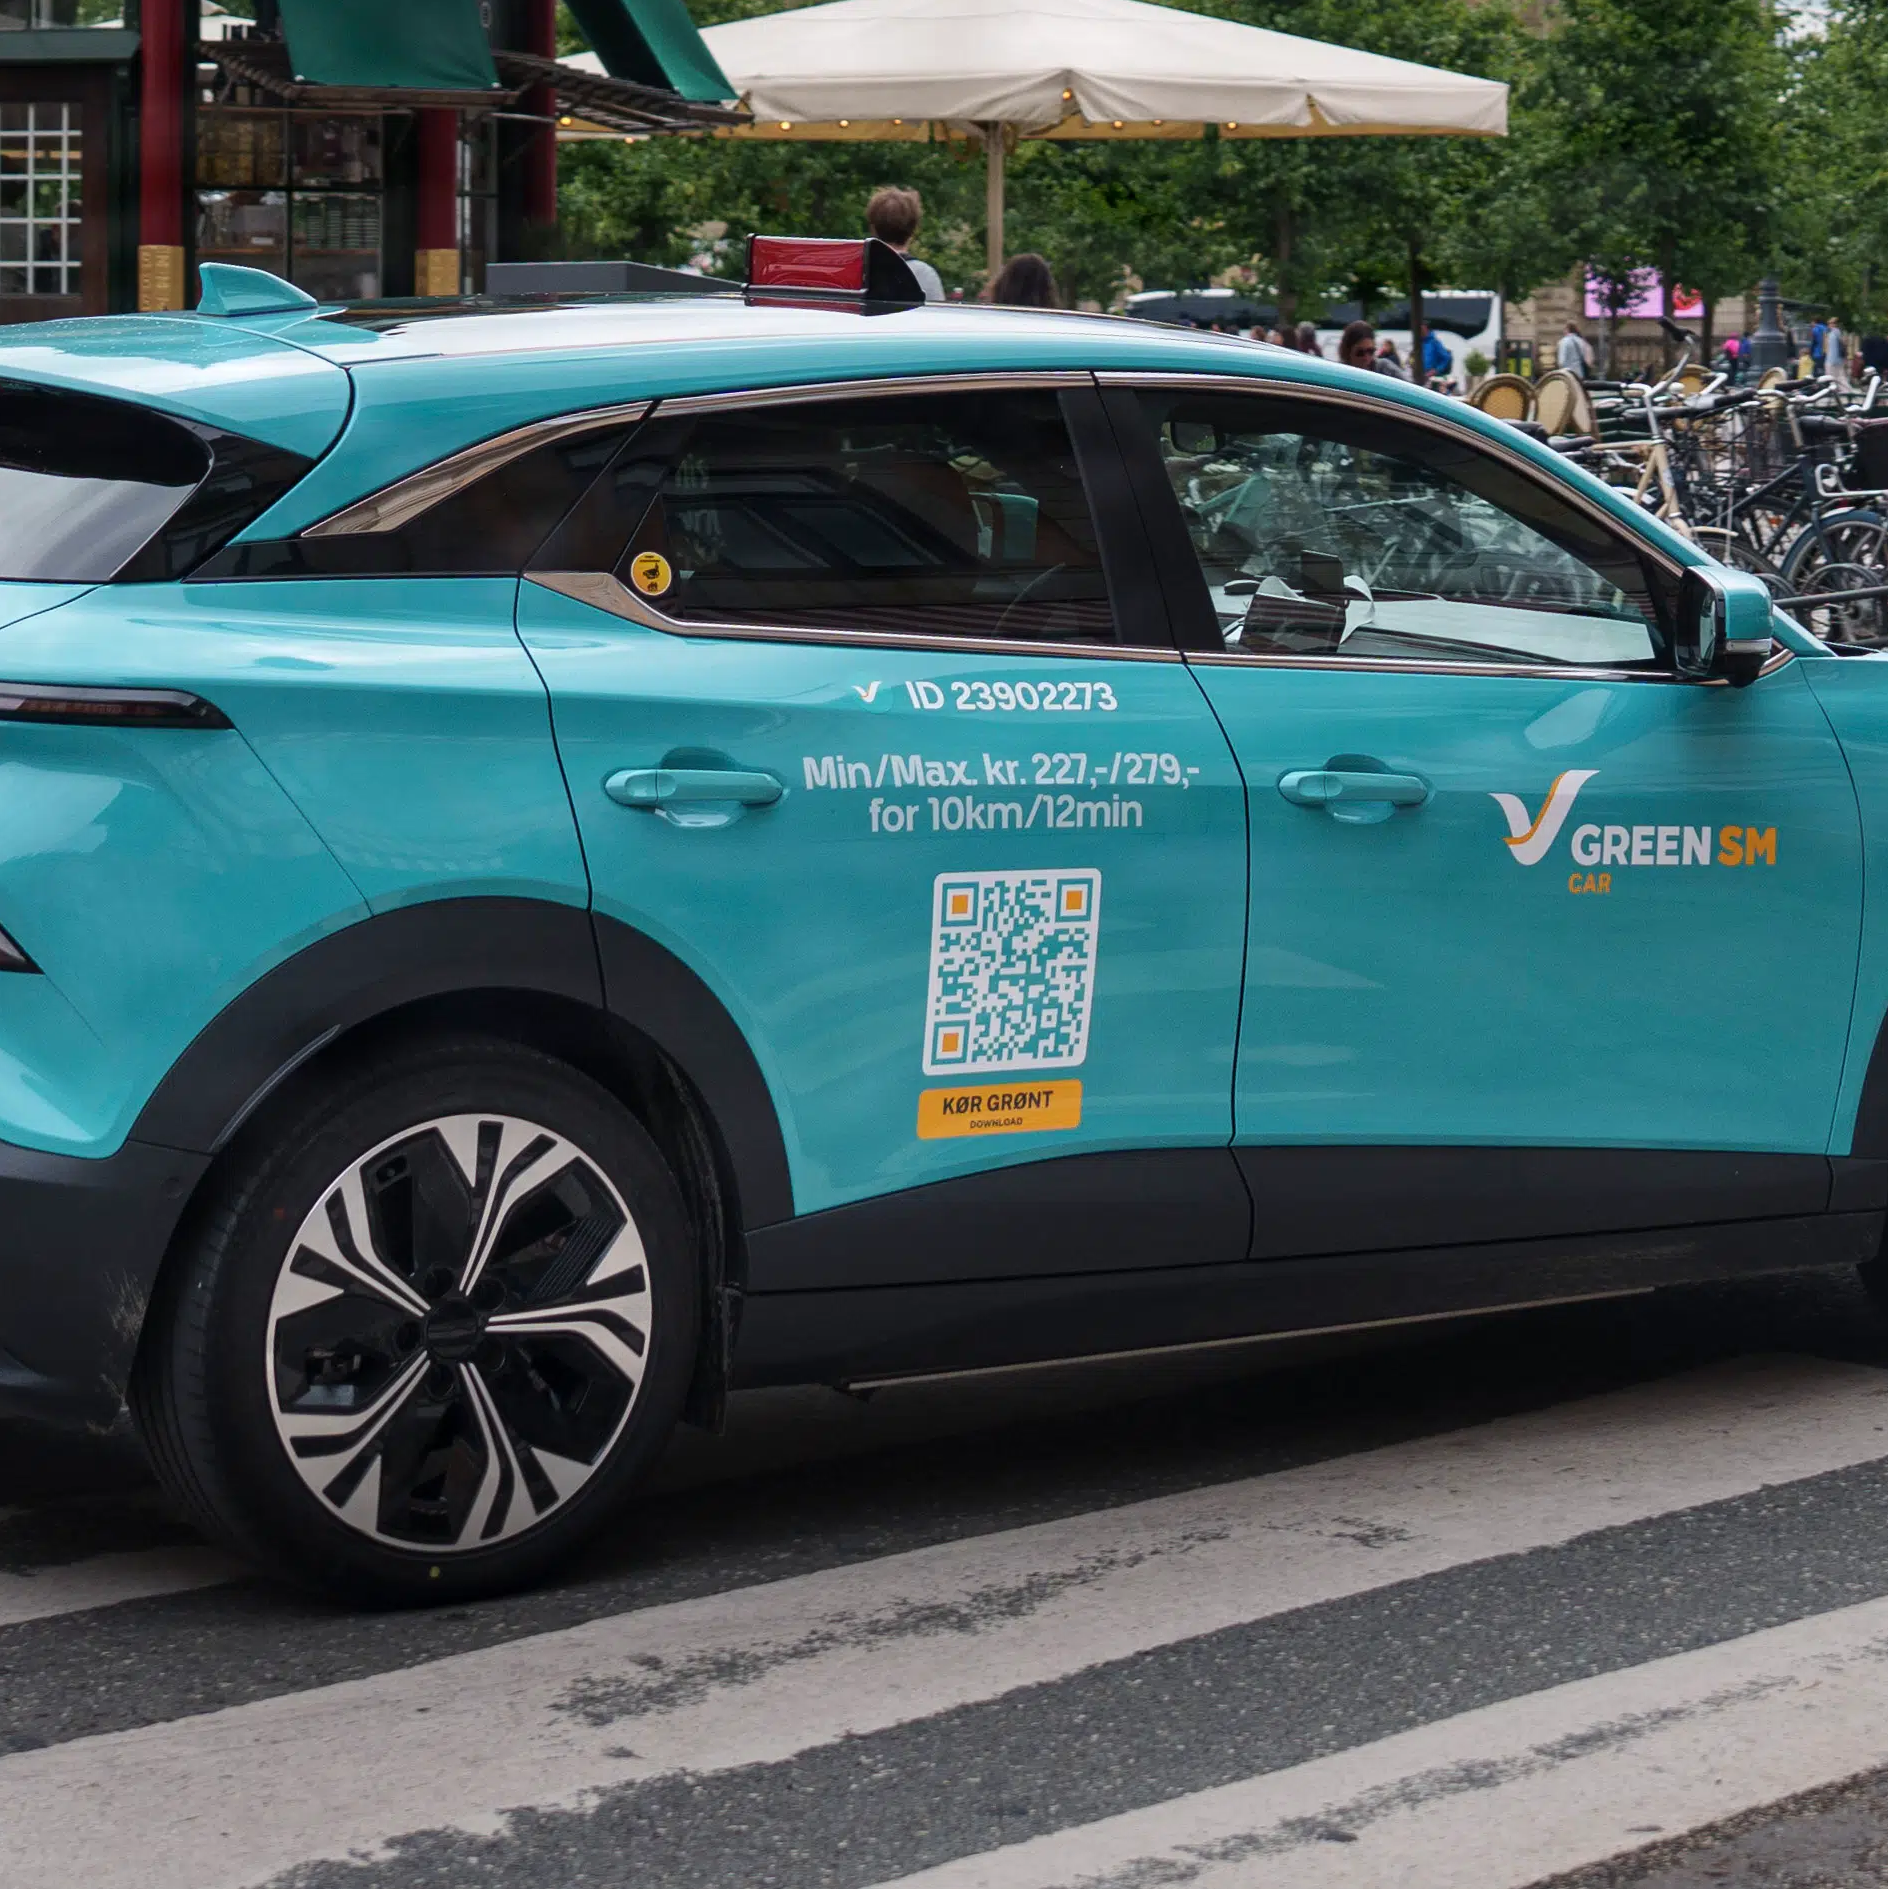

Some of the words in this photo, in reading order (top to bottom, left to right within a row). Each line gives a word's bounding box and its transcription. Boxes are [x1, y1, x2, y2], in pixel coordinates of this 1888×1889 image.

[905, 680, 945, 710] ID
[951, 681, 1118, 712] 23902273
[802, 753, 979, 790] Min/Max.
[982, 752, 1027, 786] kr.
[868, 797, 920, 833] for
[927, 793, 1143, 831] 10km/12min
[1568, 872, 1611, 894] CAR
[942, 1094, 983, 1116] KØR
[986, 1089, 1055, 1112] GRØNT
[969, 1116, 1024, 1129] DOWNLOAD
